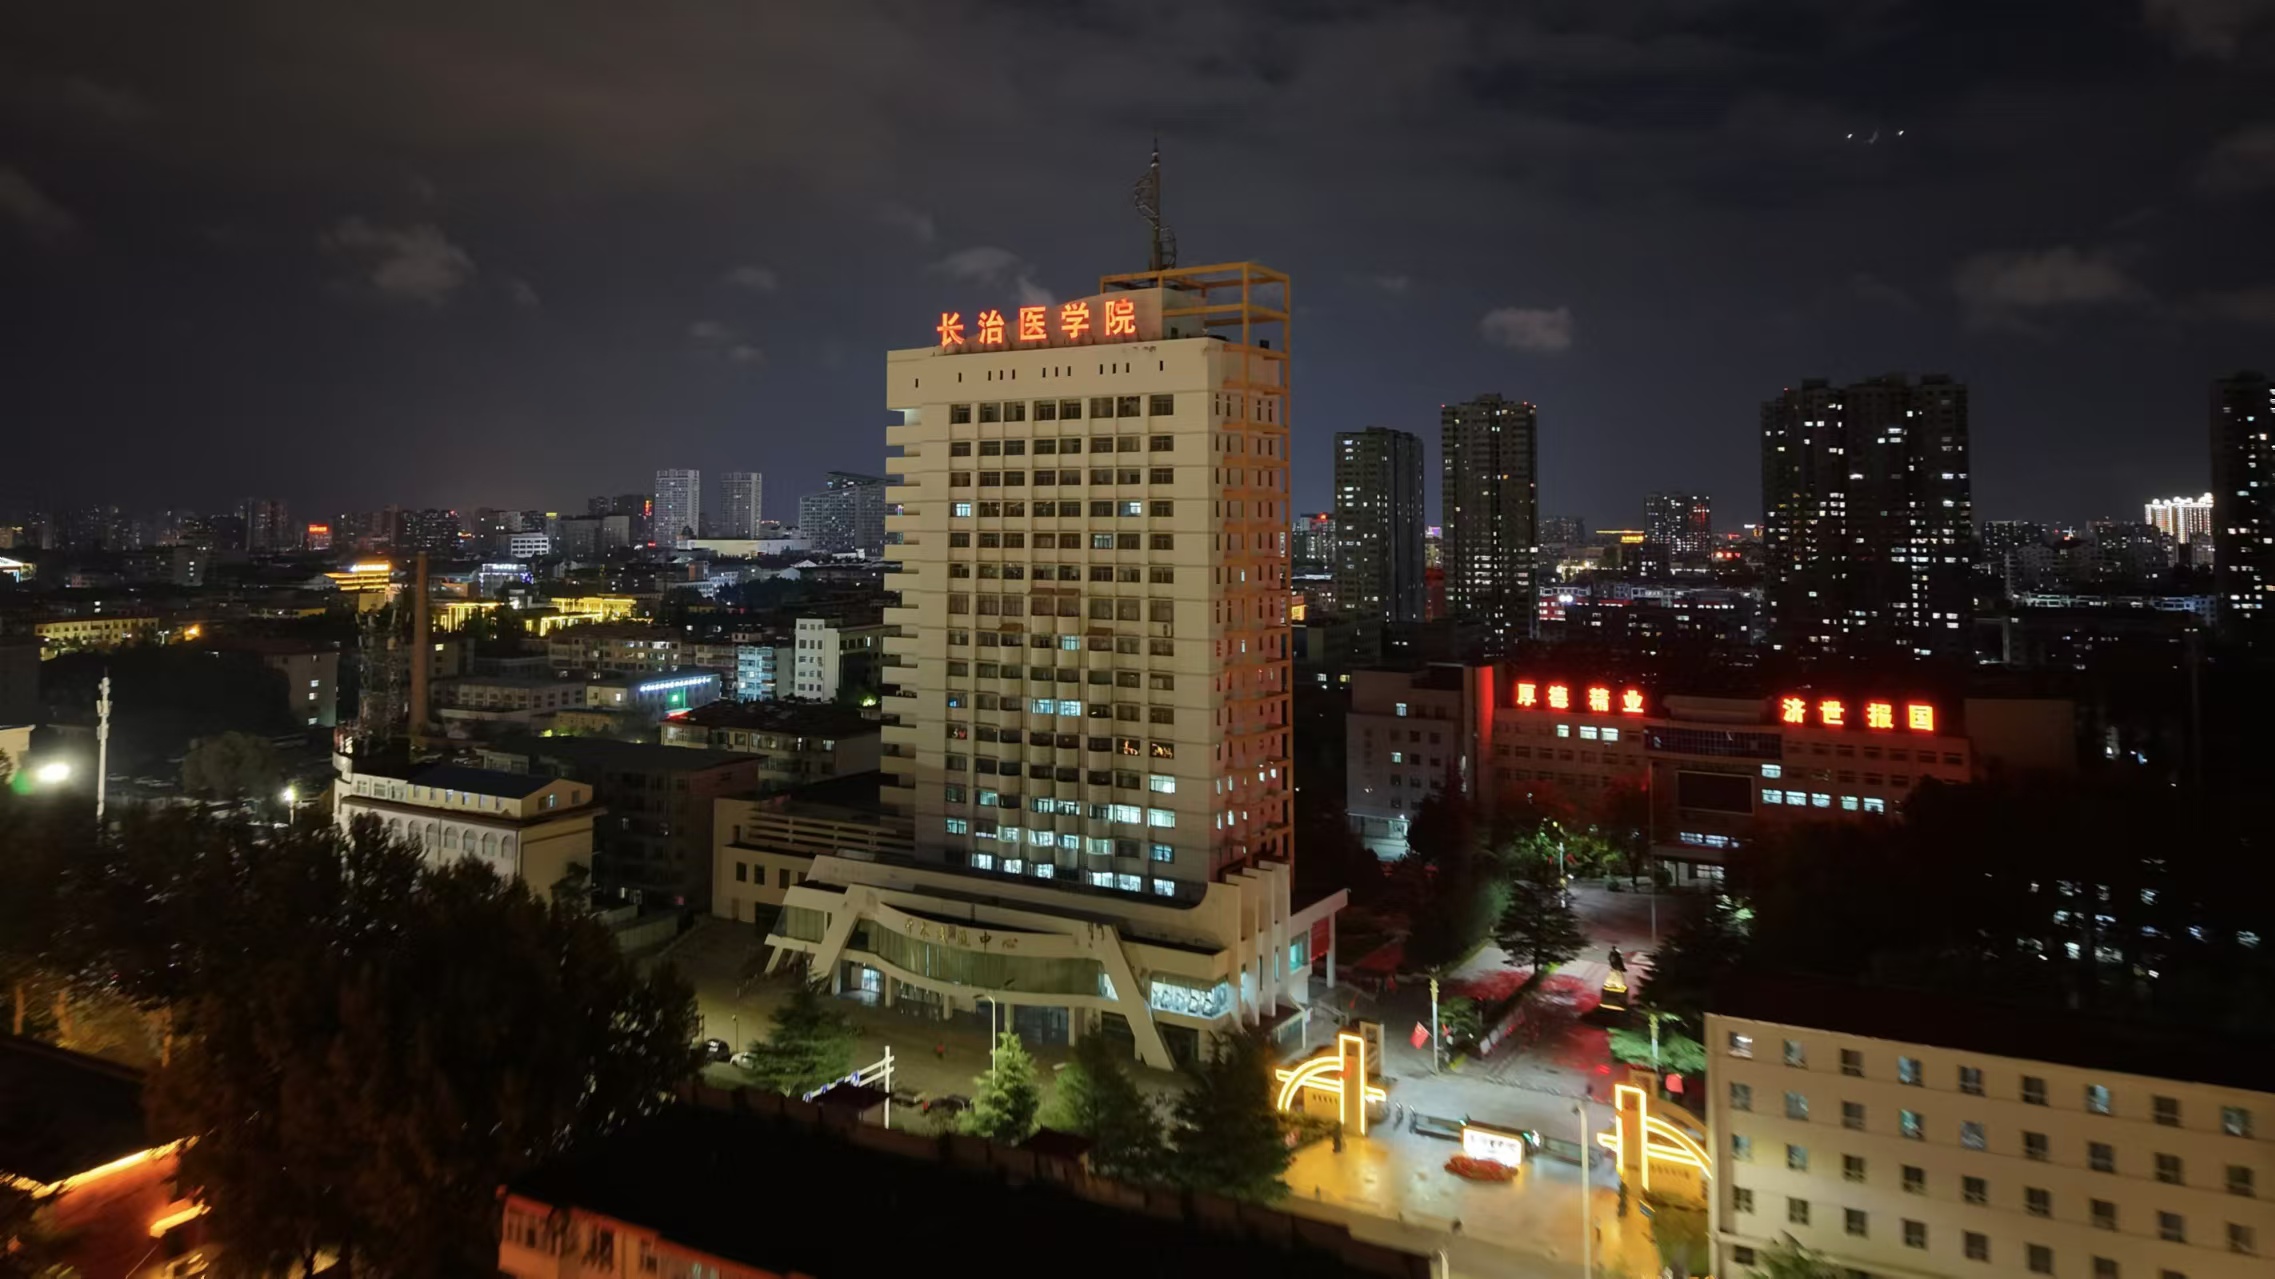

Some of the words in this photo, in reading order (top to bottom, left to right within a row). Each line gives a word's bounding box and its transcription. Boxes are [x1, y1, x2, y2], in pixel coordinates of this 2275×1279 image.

[936, 298, 1136, 347] 长治医学院
[1516, 683, 1644, 713] 厚德精业
[1782, 698, 1934, 731] 济世报国
